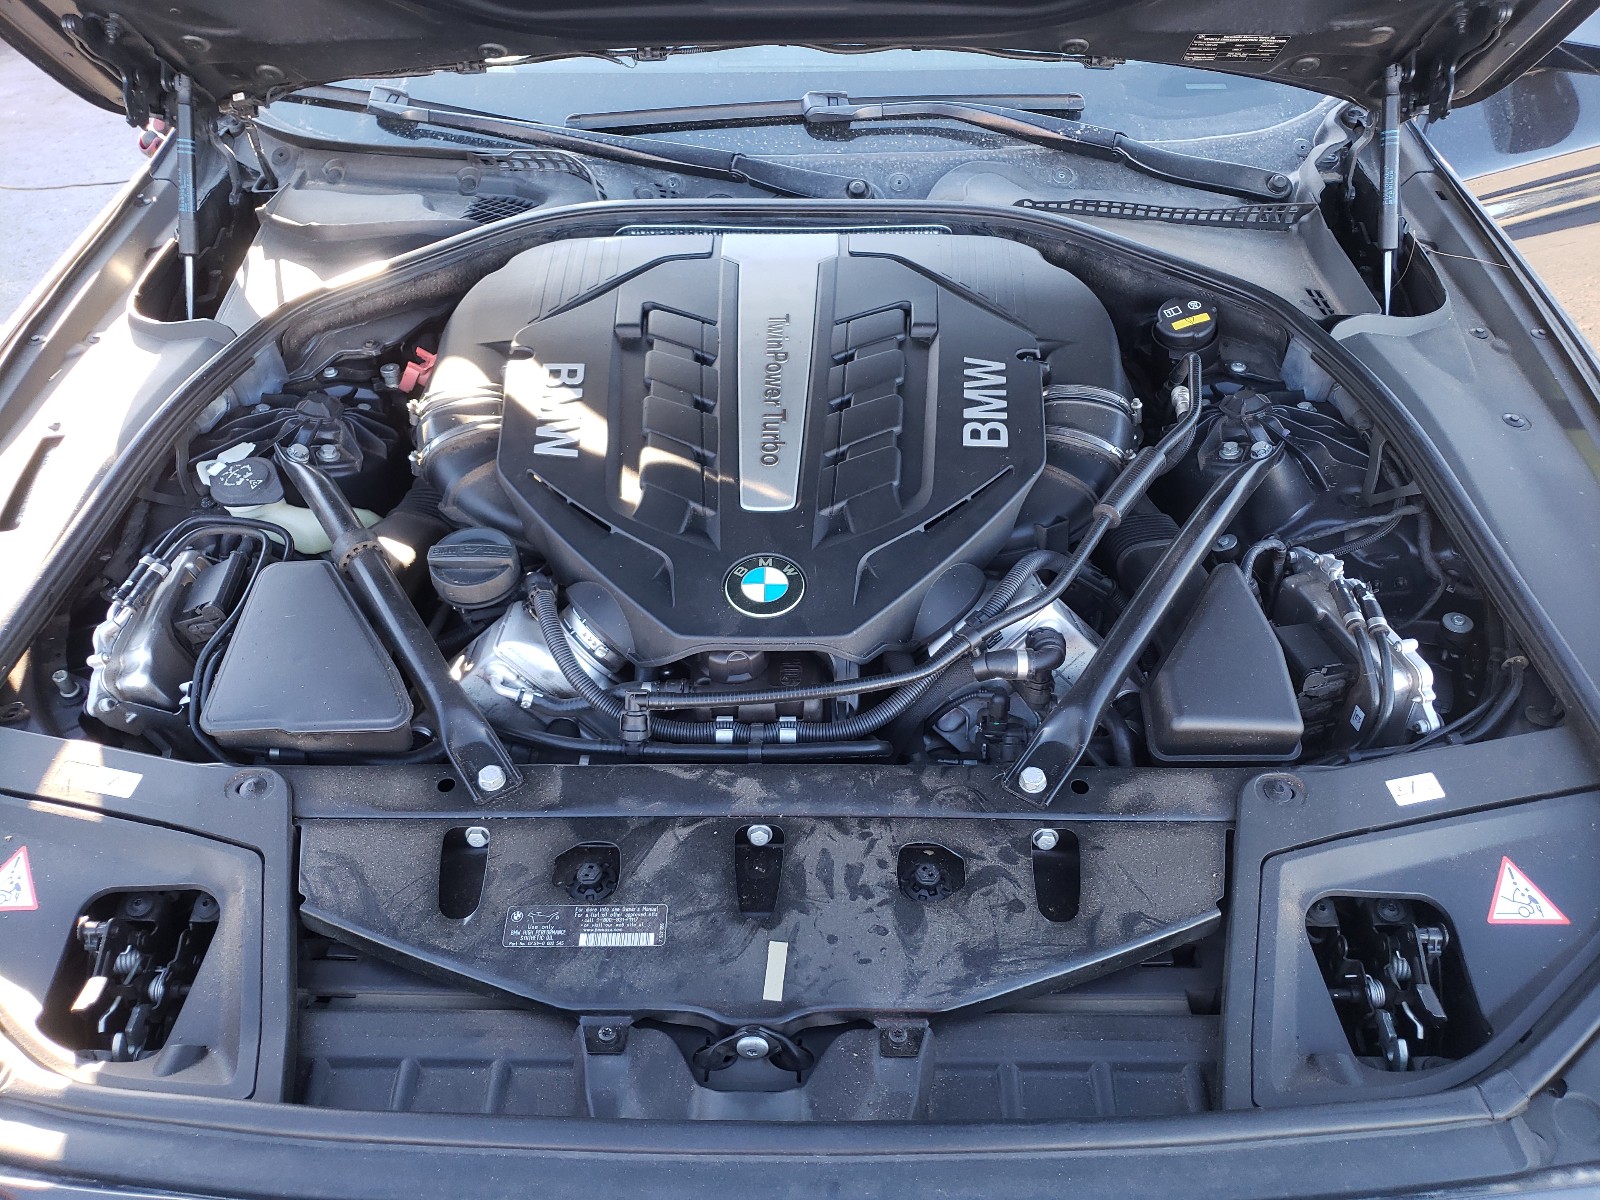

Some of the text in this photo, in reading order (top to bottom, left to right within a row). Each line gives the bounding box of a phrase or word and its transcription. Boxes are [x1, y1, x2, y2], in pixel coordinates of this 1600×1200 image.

[533, 363, 586, 458] BMW
[760, 313, 790, 467] TwinPower Turbo
[962, 356, 1009, 447] BMW
[733, 557, 798, 577] BMW
